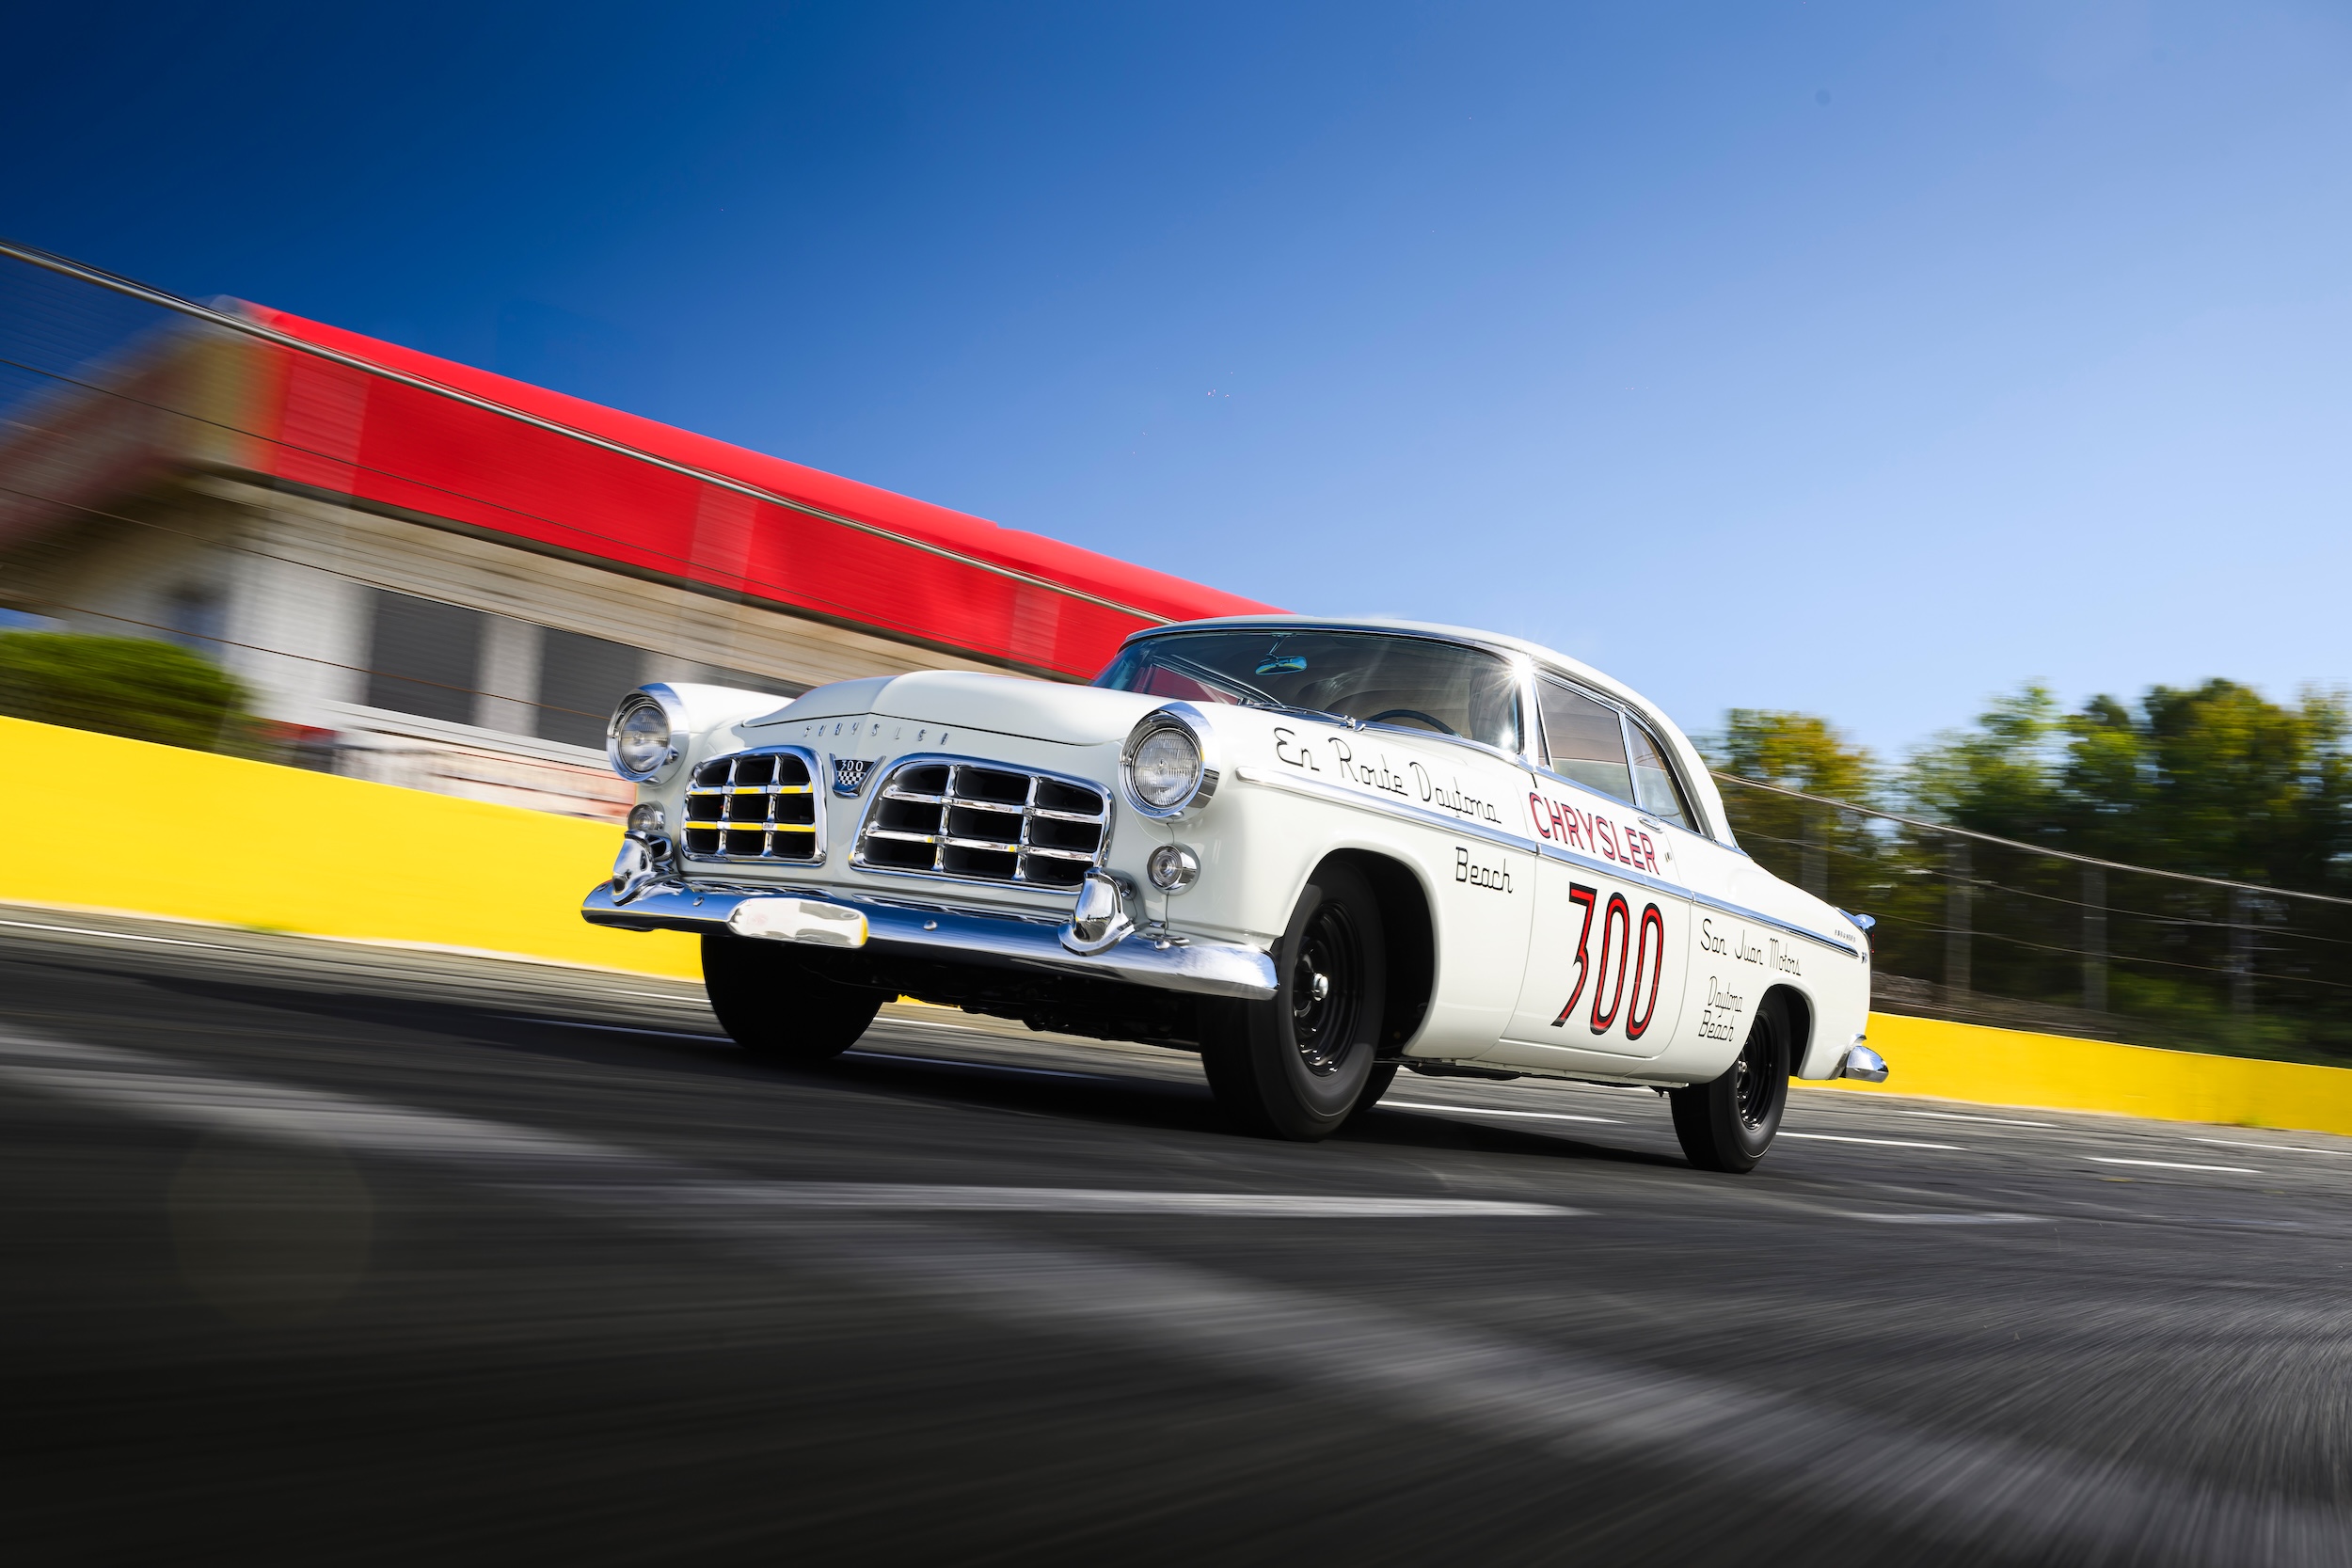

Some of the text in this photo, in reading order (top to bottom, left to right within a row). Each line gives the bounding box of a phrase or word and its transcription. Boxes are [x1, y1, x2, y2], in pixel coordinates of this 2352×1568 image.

[841, 760, 865, 771] 300
[1274, 727, 1502, 825] En Route Daytona
[1529, 791, 1660, 876] CHRYSLER
[1455, 847, 1514, 895] Beach
[1551, 881, 1664, 1041] 300
[1700, 918, 1802, 976] San Juan Motors
[1708, 975, 1743, 1019] Daytona
[1697, 1009, 1734, 1042] Beach
